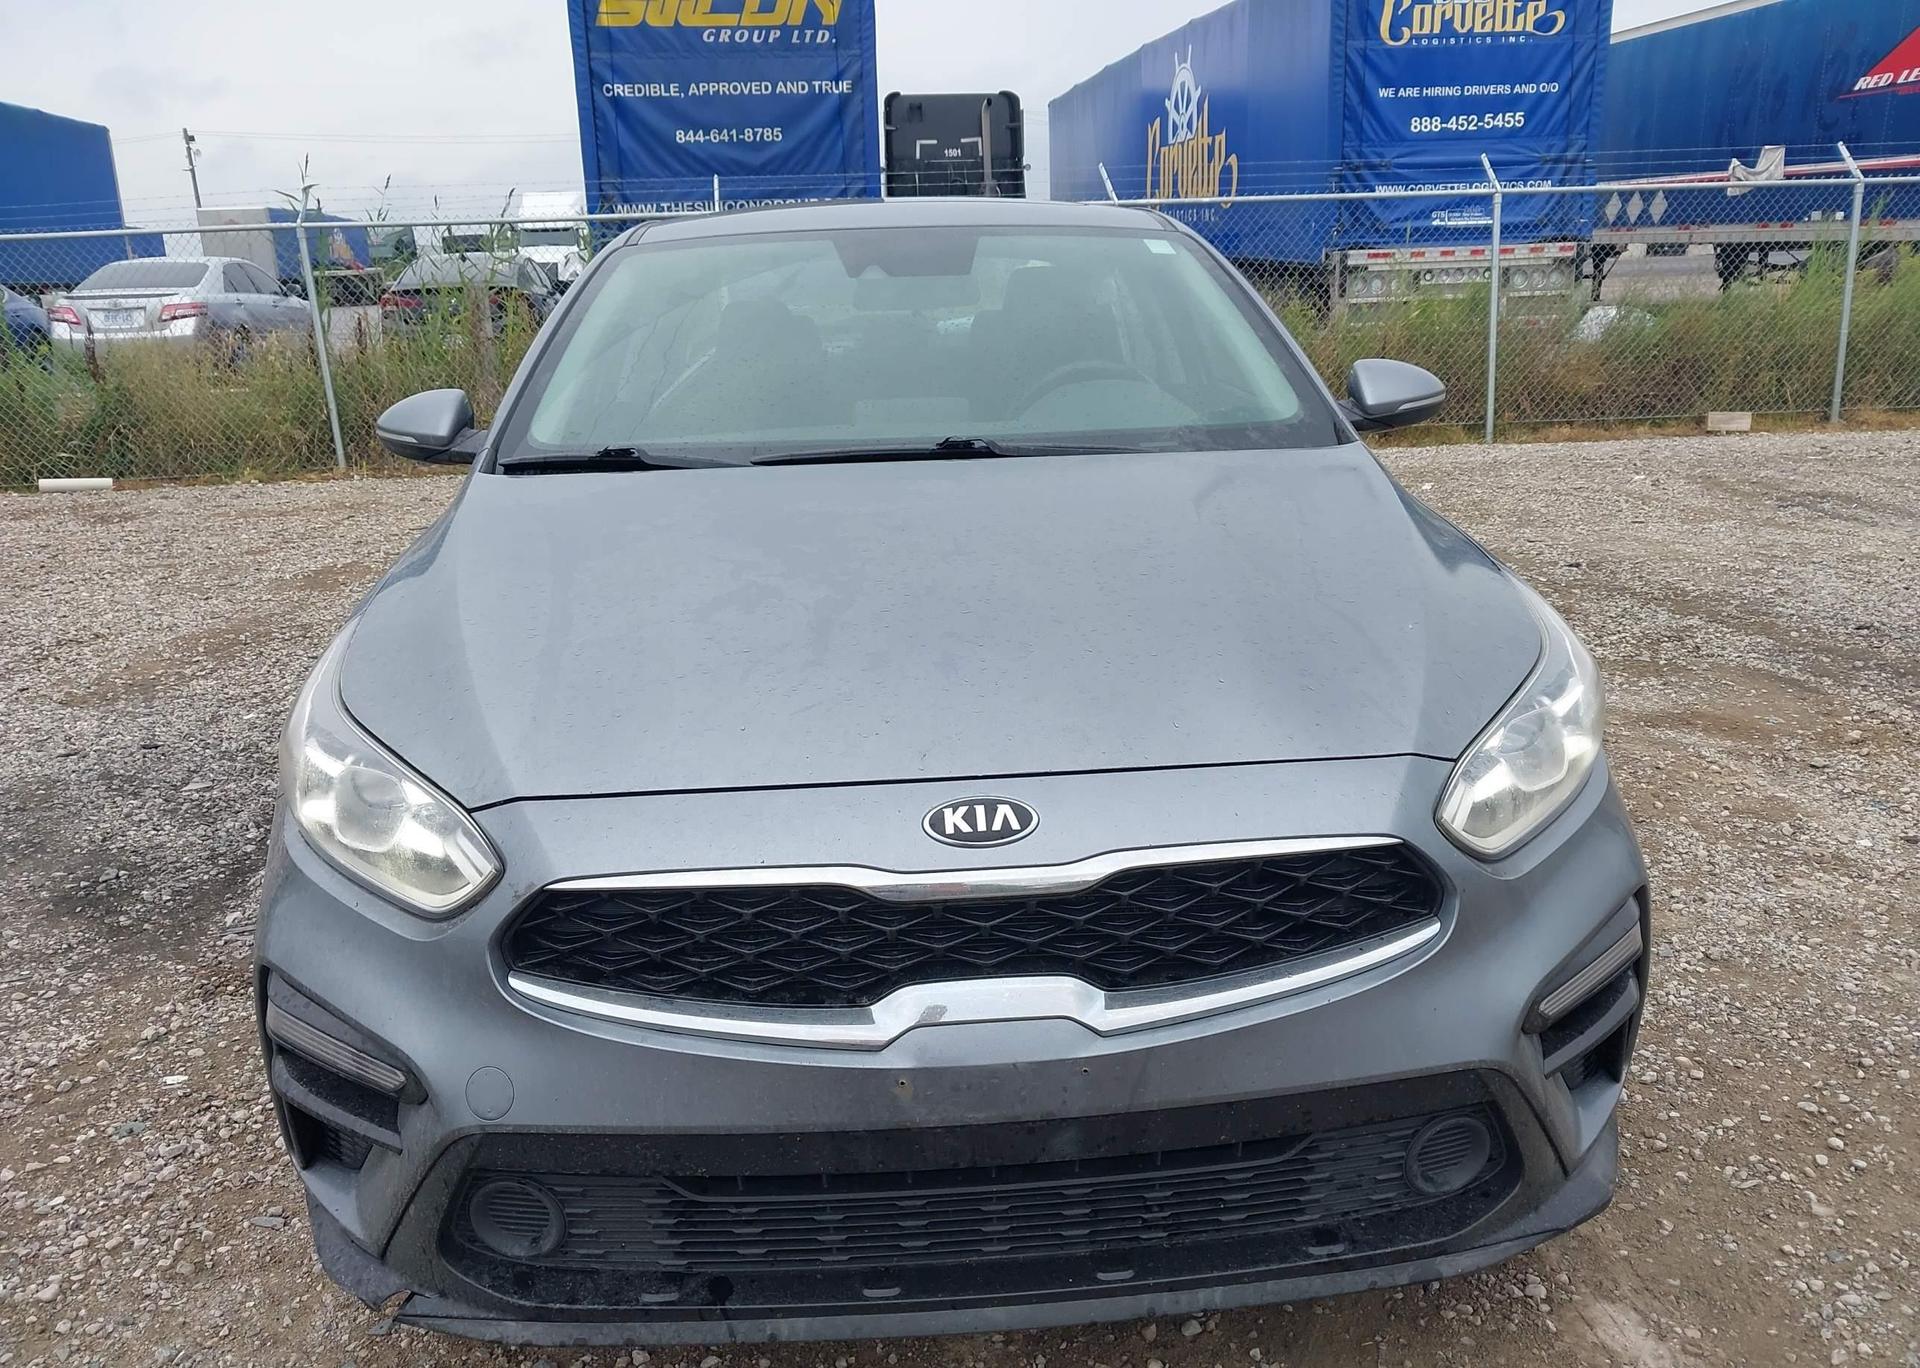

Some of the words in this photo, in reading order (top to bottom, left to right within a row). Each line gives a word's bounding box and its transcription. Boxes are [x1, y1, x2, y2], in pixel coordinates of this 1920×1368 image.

[702, 28, 781, 43] GROUP
[791, 29, 837, 43] LTD.
[1412, 36, 1492, 46] LOGISTICS
[1501, 35, 1534, 43] INC.
[602, 83, 685, 99] CREDIBLE,
[688, 81, 772, 97] APPROVED
[775, 80, 809, 95] AND
[812, 80, 853, 94] TRUE
[1853, 72, 1895, 91] RED
[1378, 87, 1396, 98] WE
[1397, 87, 1421, 97] ARE
[1422, 85, 1462, 97] HIRING
[1464, 84, 1511, 96] DRIVERS
[1513, 83, 1537, 94] AND
[1410, 111, 1525, 133] 888-452-5455
[675, 127, 783, 144] 844-641-8785
[944, 148, 962, 157] 1501
[942, 804, 1021, 835] KIA
